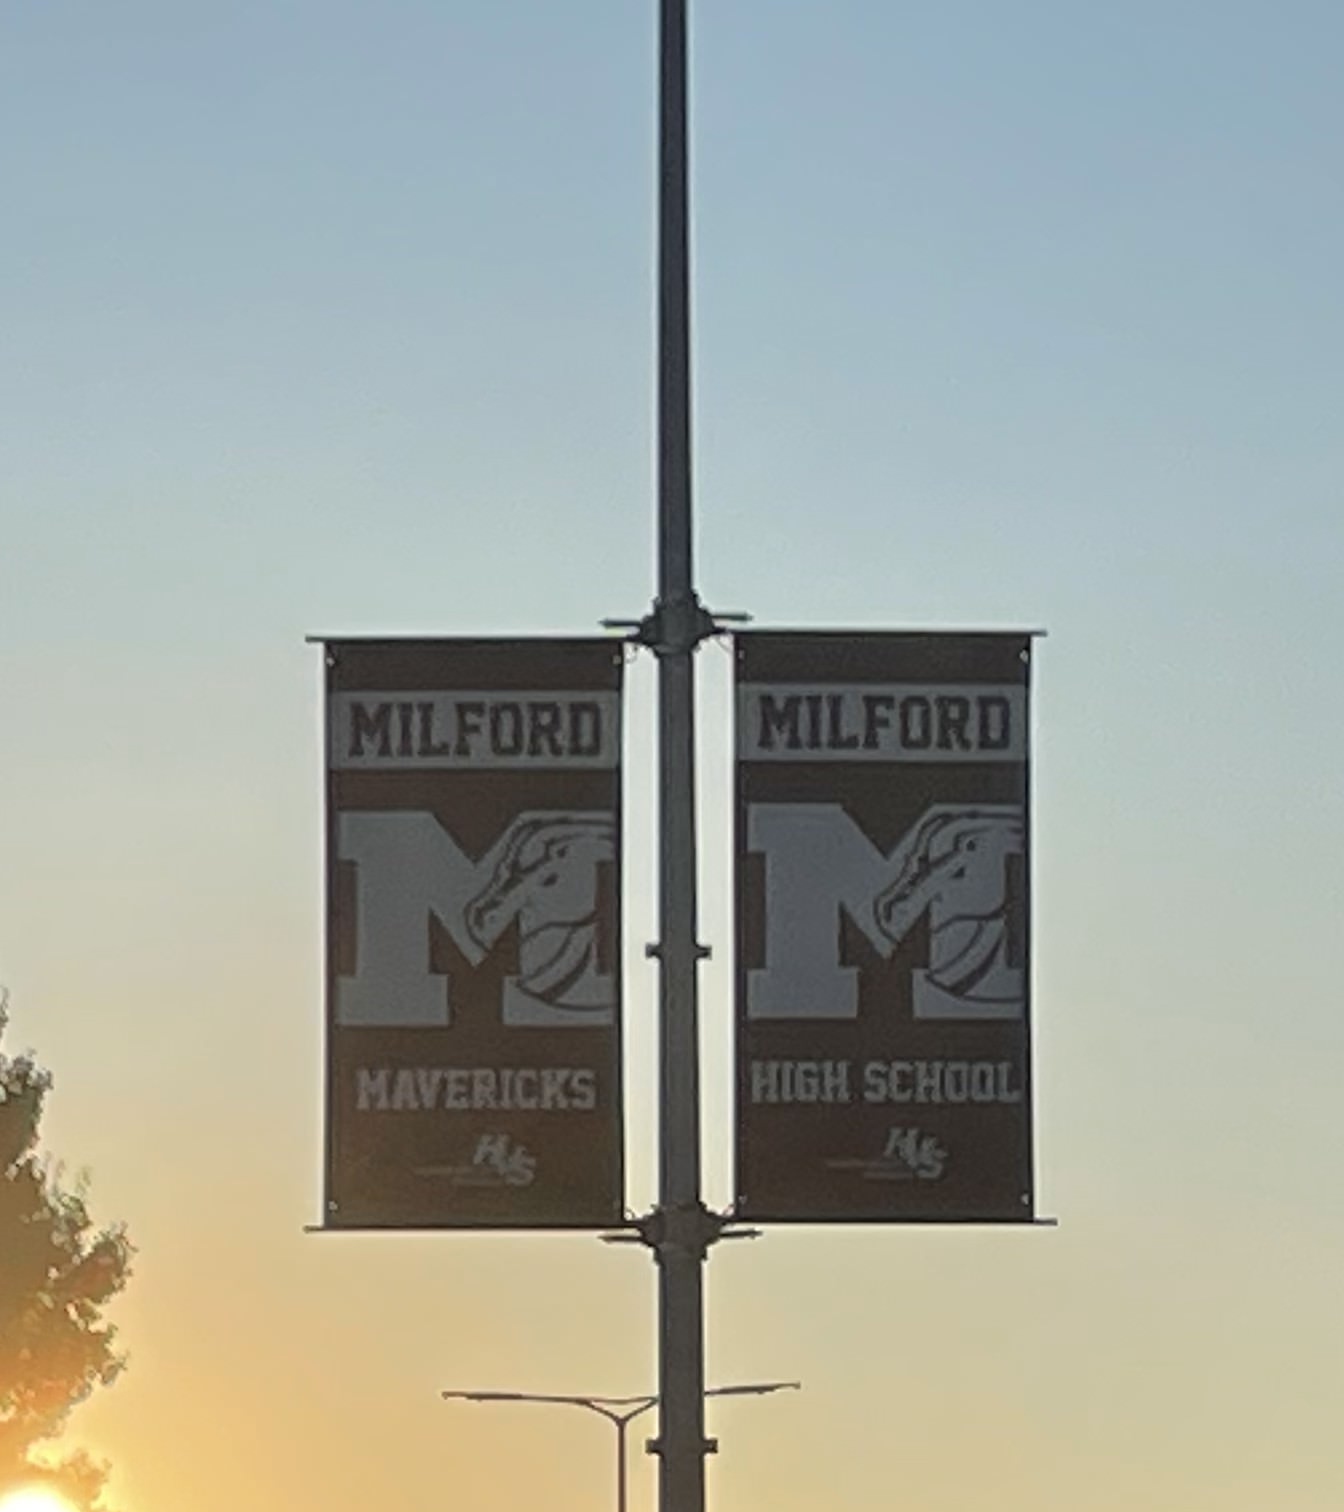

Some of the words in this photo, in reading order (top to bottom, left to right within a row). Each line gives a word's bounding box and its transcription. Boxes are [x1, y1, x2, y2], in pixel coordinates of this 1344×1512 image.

[347, 701, 602, 758] MILFORD
[756, 693, 1011, 751] MILFORD
[337, 810, 614, 1026] M
[747, 802, 1023, 1020] M
[356, 1067, 597, 1111] MAVERICKS
[752, 1061, 851, 1103] HIGH
[863, 1060, 1020, 1102] SCHOOL
